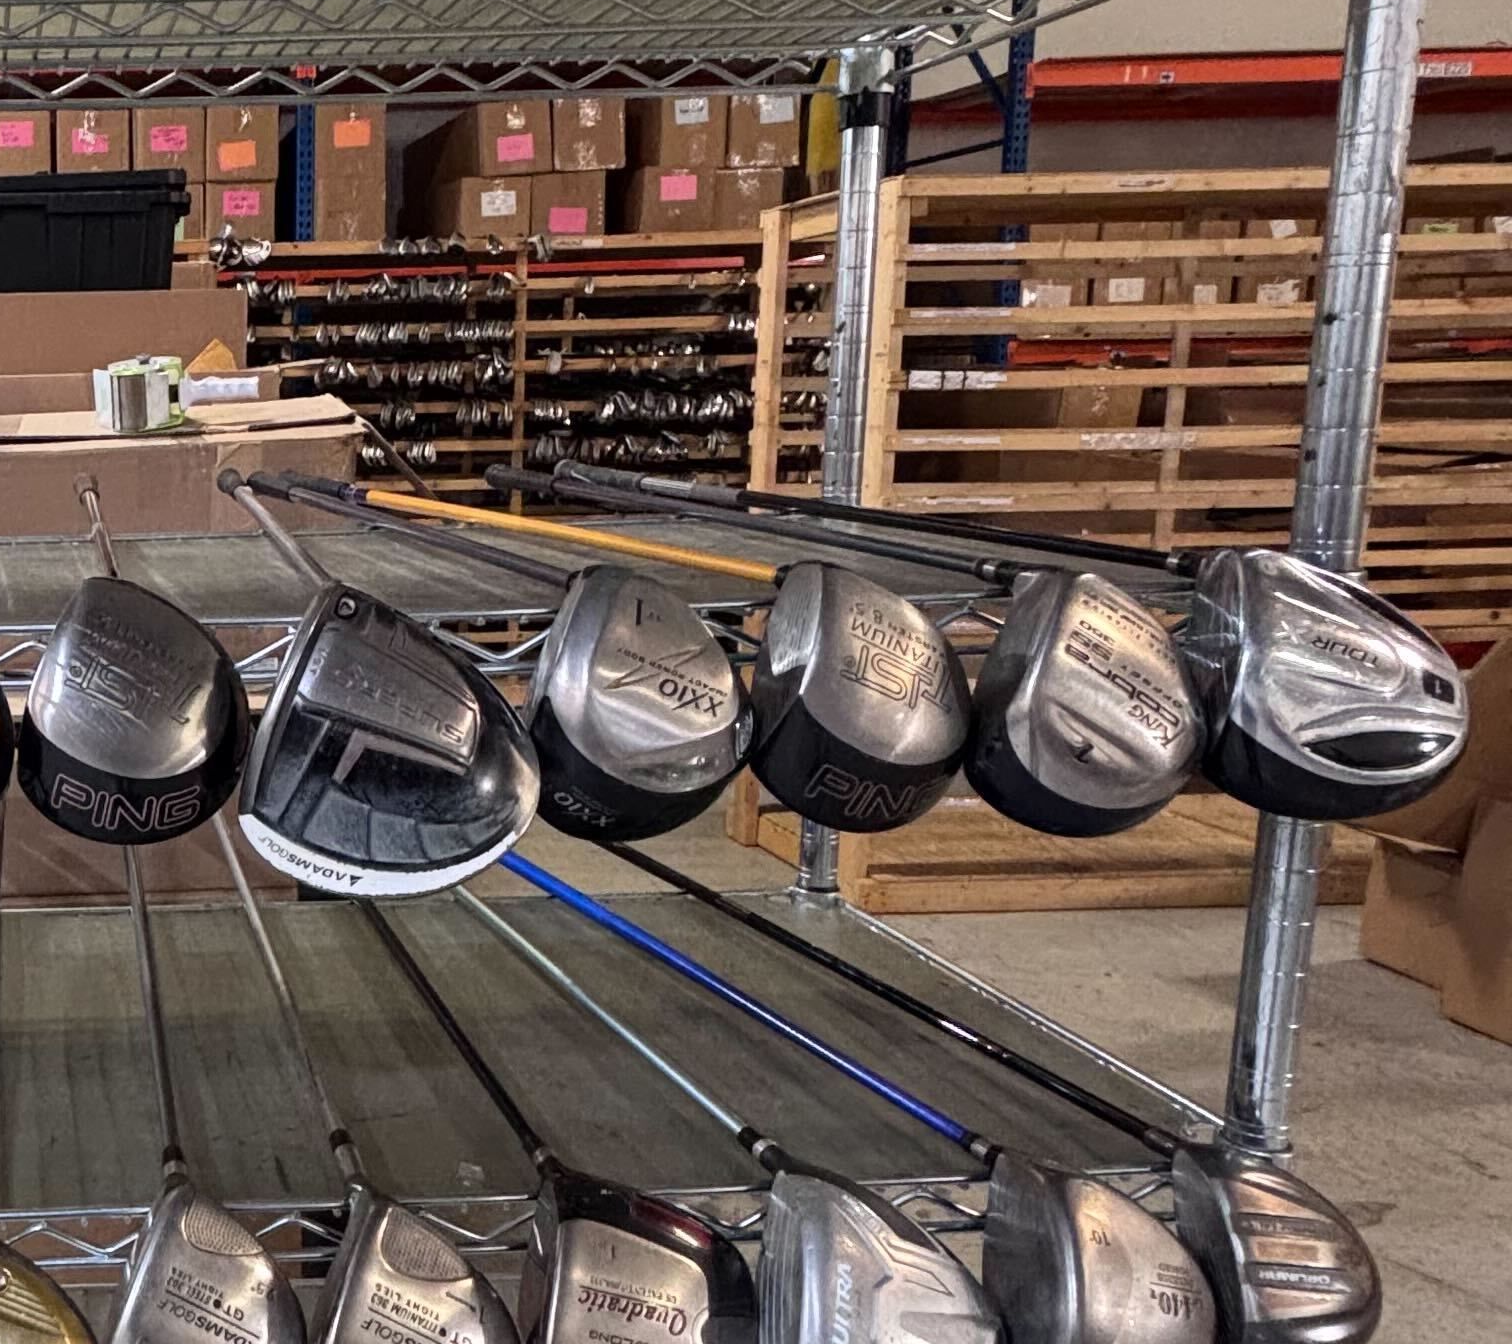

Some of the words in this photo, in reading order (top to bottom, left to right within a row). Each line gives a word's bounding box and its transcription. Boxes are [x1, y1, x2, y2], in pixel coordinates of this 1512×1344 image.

[1312, 636, 1380, 667] TOUR
[659, 679, 724, 717] XXIO
[1065, 644, 1180, 727] cobra
[51, 773, 201, 832] PING
[258, 836, 350, 885] ADAMSGOLF
[187, 1286, 212, 1306] STEEL
[375, 1282, 401, 1301] LIES
[223, 1305, 245, 1321] GT
[390, 1304, 438, 1333] TITANIUM
[405, 1300, 440, 1321] TIGHT
[578, 1288, 687, 1336] Quadratic
